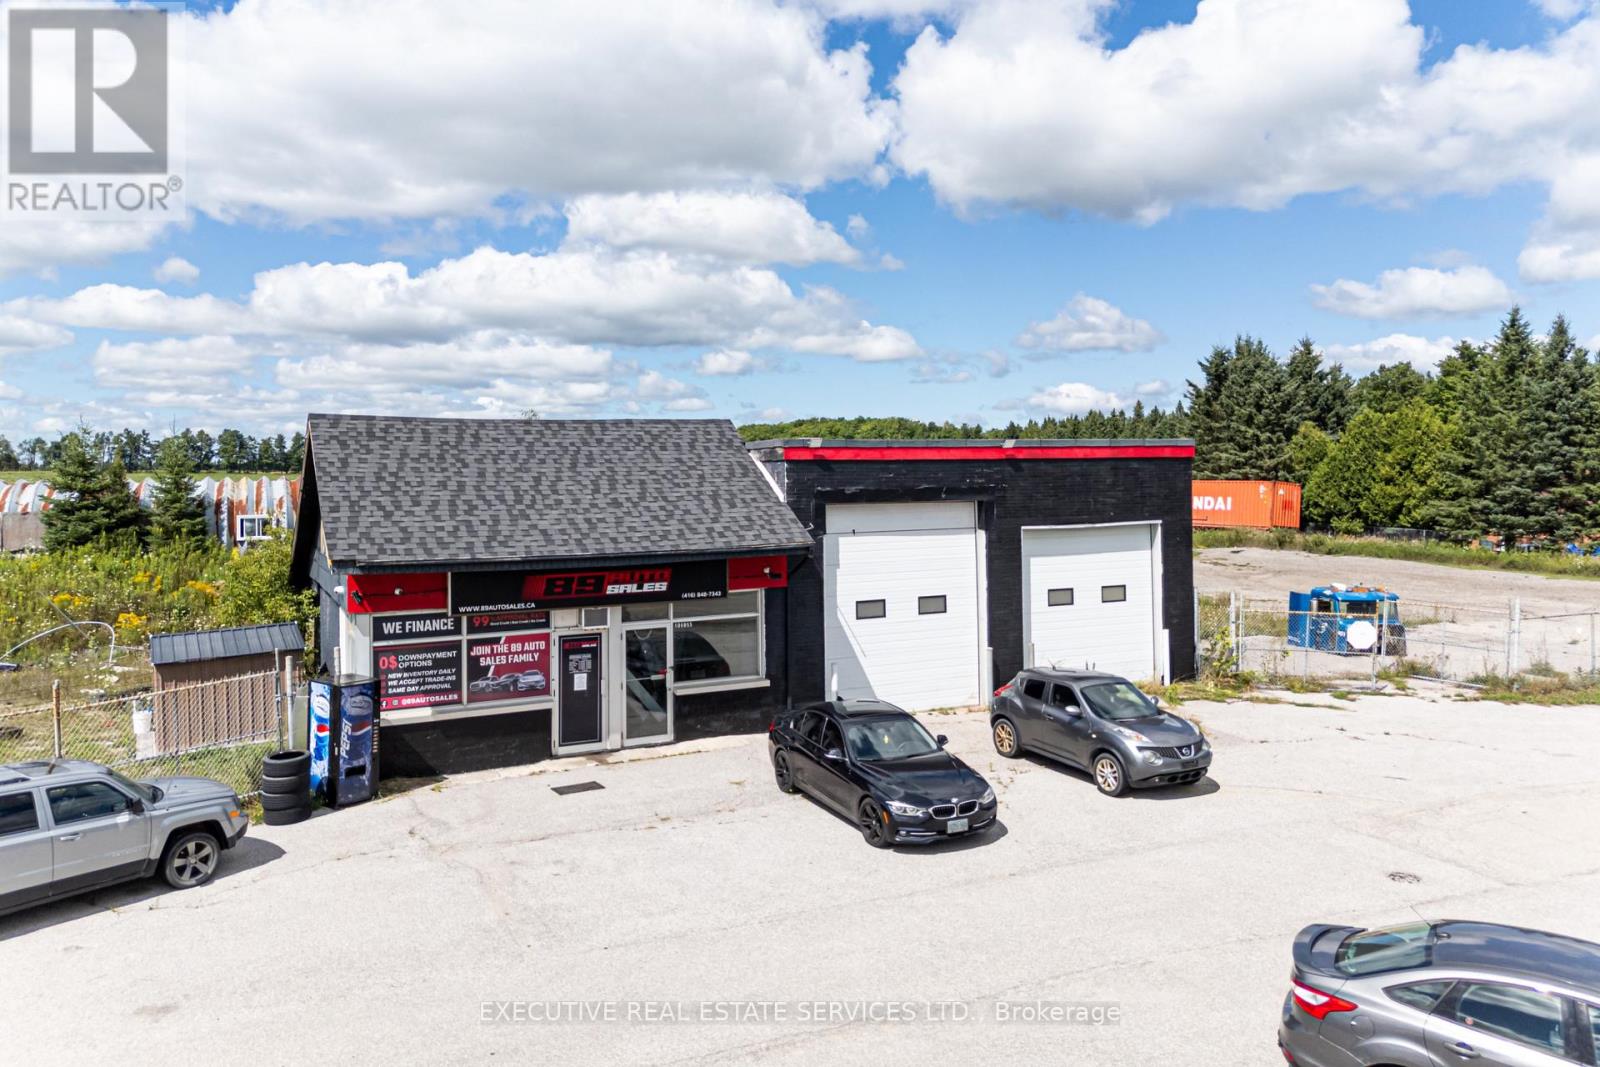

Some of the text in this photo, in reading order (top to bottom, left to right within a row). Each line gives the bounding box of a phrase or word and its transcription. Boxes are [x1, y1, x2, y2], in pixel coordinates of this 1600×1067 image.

[608, 568, 672, 583] AUTO
[543, 574, 605, 596] 89
[606, 582, 668, 595] SALES
[458, 602, 536, 613] WWW.89AUTOSALES.CA
[382, 618, 455, 635] WE FINANCE
[470, 641, 546, 656] JOIN THE 89 AUTO
[379, 655, 398, 670] 0$
[398, 650, 457, 662] DOWNPAYMENT
[480, 652, 540, 666] SALES FAMILY
[398, 660, 433, 669] OPTIONS
[387, 672, 402, 680] NEW
[403, 670, 438, 678] INVENTORY
[387, 679, 399, 687] WE
[387, 686, 406, 694] SAME
[419, 683, 452, 691] APPROVAL
[340, 717, 353, 759] PEPSI
